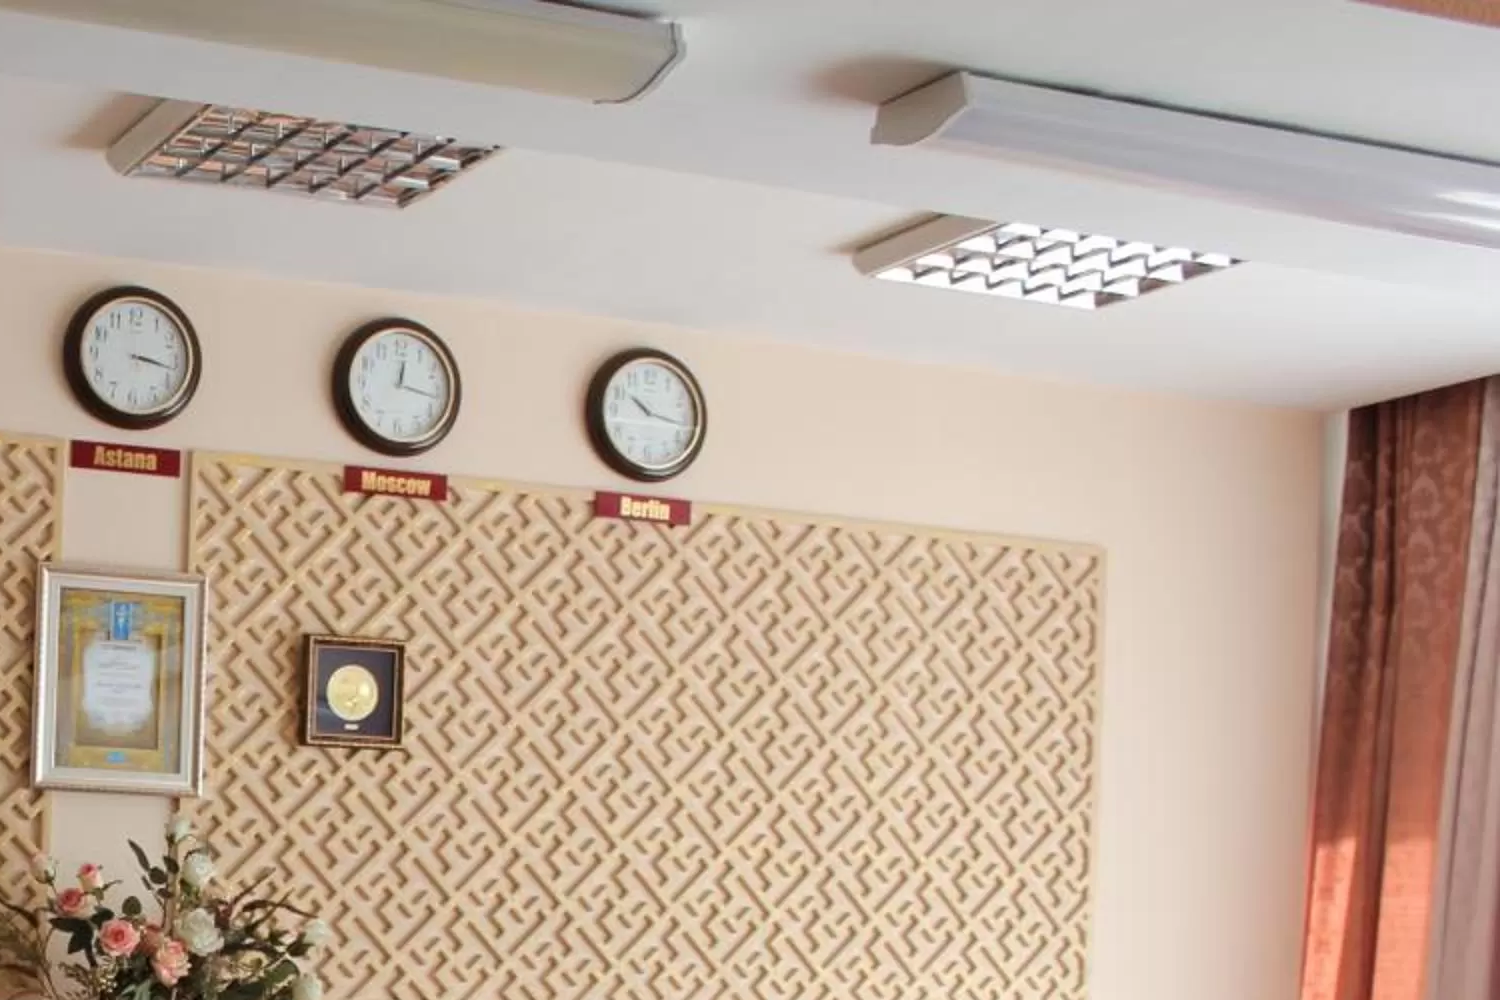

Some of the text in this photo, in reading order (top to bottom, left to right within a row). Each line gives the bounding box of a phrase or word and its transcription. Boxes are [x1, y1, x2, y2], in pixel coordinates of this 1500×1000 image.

[93, 445, 157, 471] Astana
[361, 471, 431, 496] Moscow
[621, 496, 670, 520] Berlin
